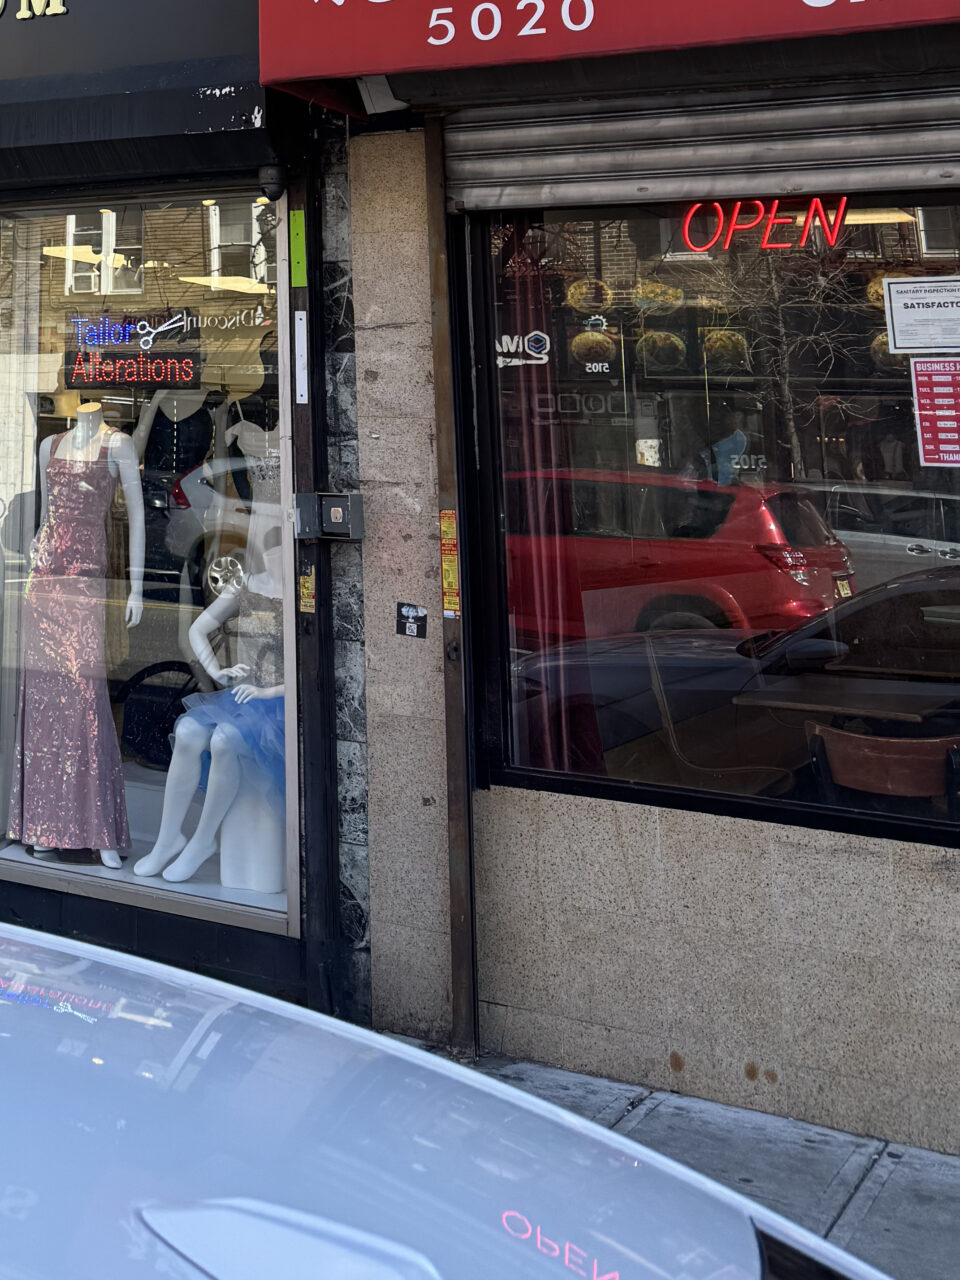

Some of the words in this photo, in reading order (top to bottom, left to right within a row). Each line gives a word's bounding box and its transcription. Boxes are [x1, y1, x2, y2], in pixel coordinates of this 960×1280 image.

[682, 196, 848, 251] OPEN
[71, 317, 136, 347] Tailor
[71, 350, 194, 384] Alterations
[916, 362, 956, 372] BUSINESS
